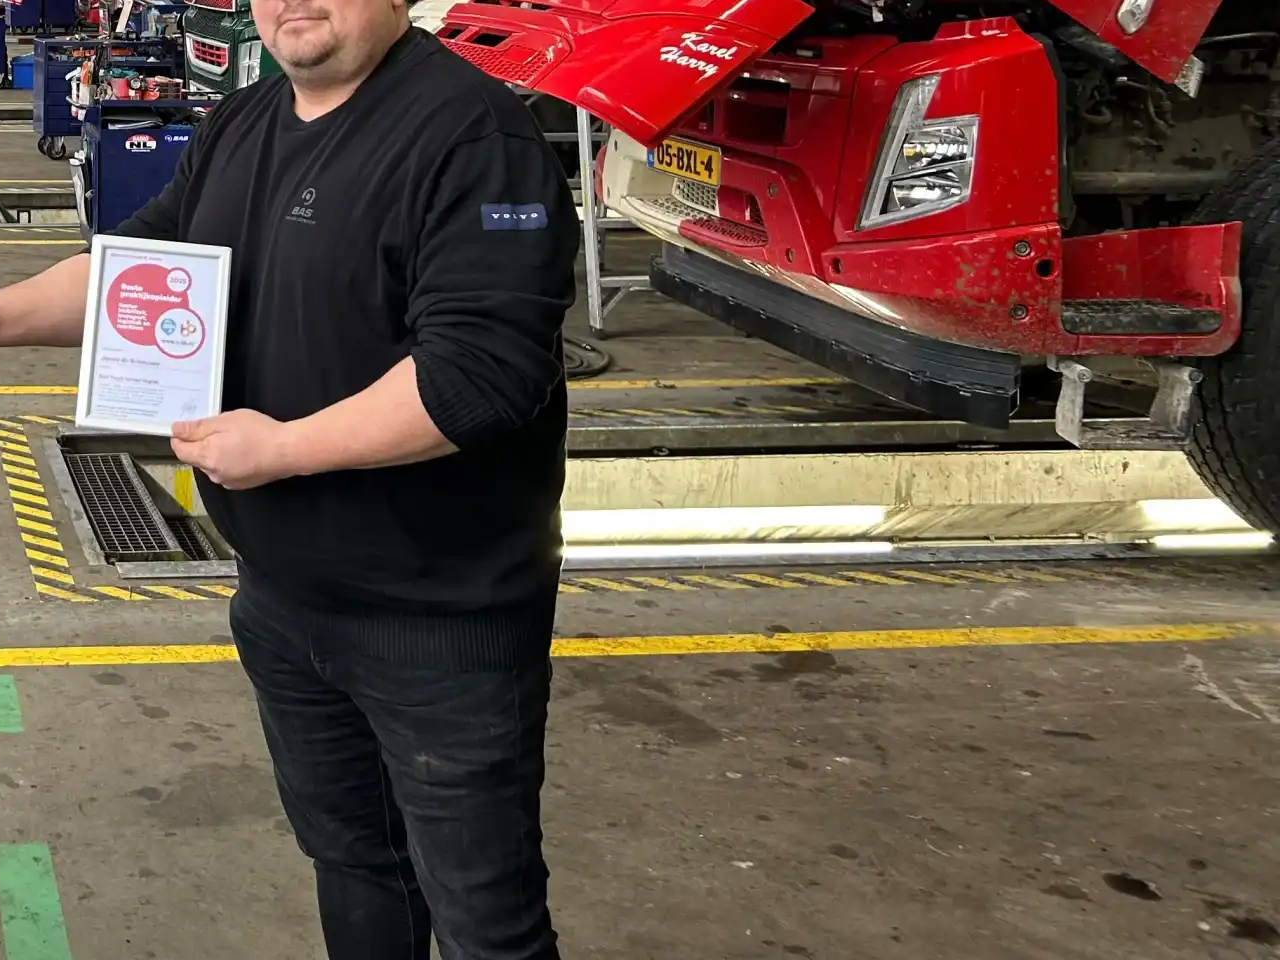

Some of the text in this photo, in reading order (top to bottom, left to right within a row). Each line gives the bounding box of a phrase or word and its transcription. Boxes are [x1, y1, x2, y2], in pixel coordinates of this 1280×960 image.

[680, 32, 738, 60] Karel
[660, 46, 719, 84] Harry
[129, 141, 152, 149] NL
[656, 142, 714, 180] 05-BXL-4
[291, 206, 314, 217] BAS
[491, 212, 539, 220] VOLVO
